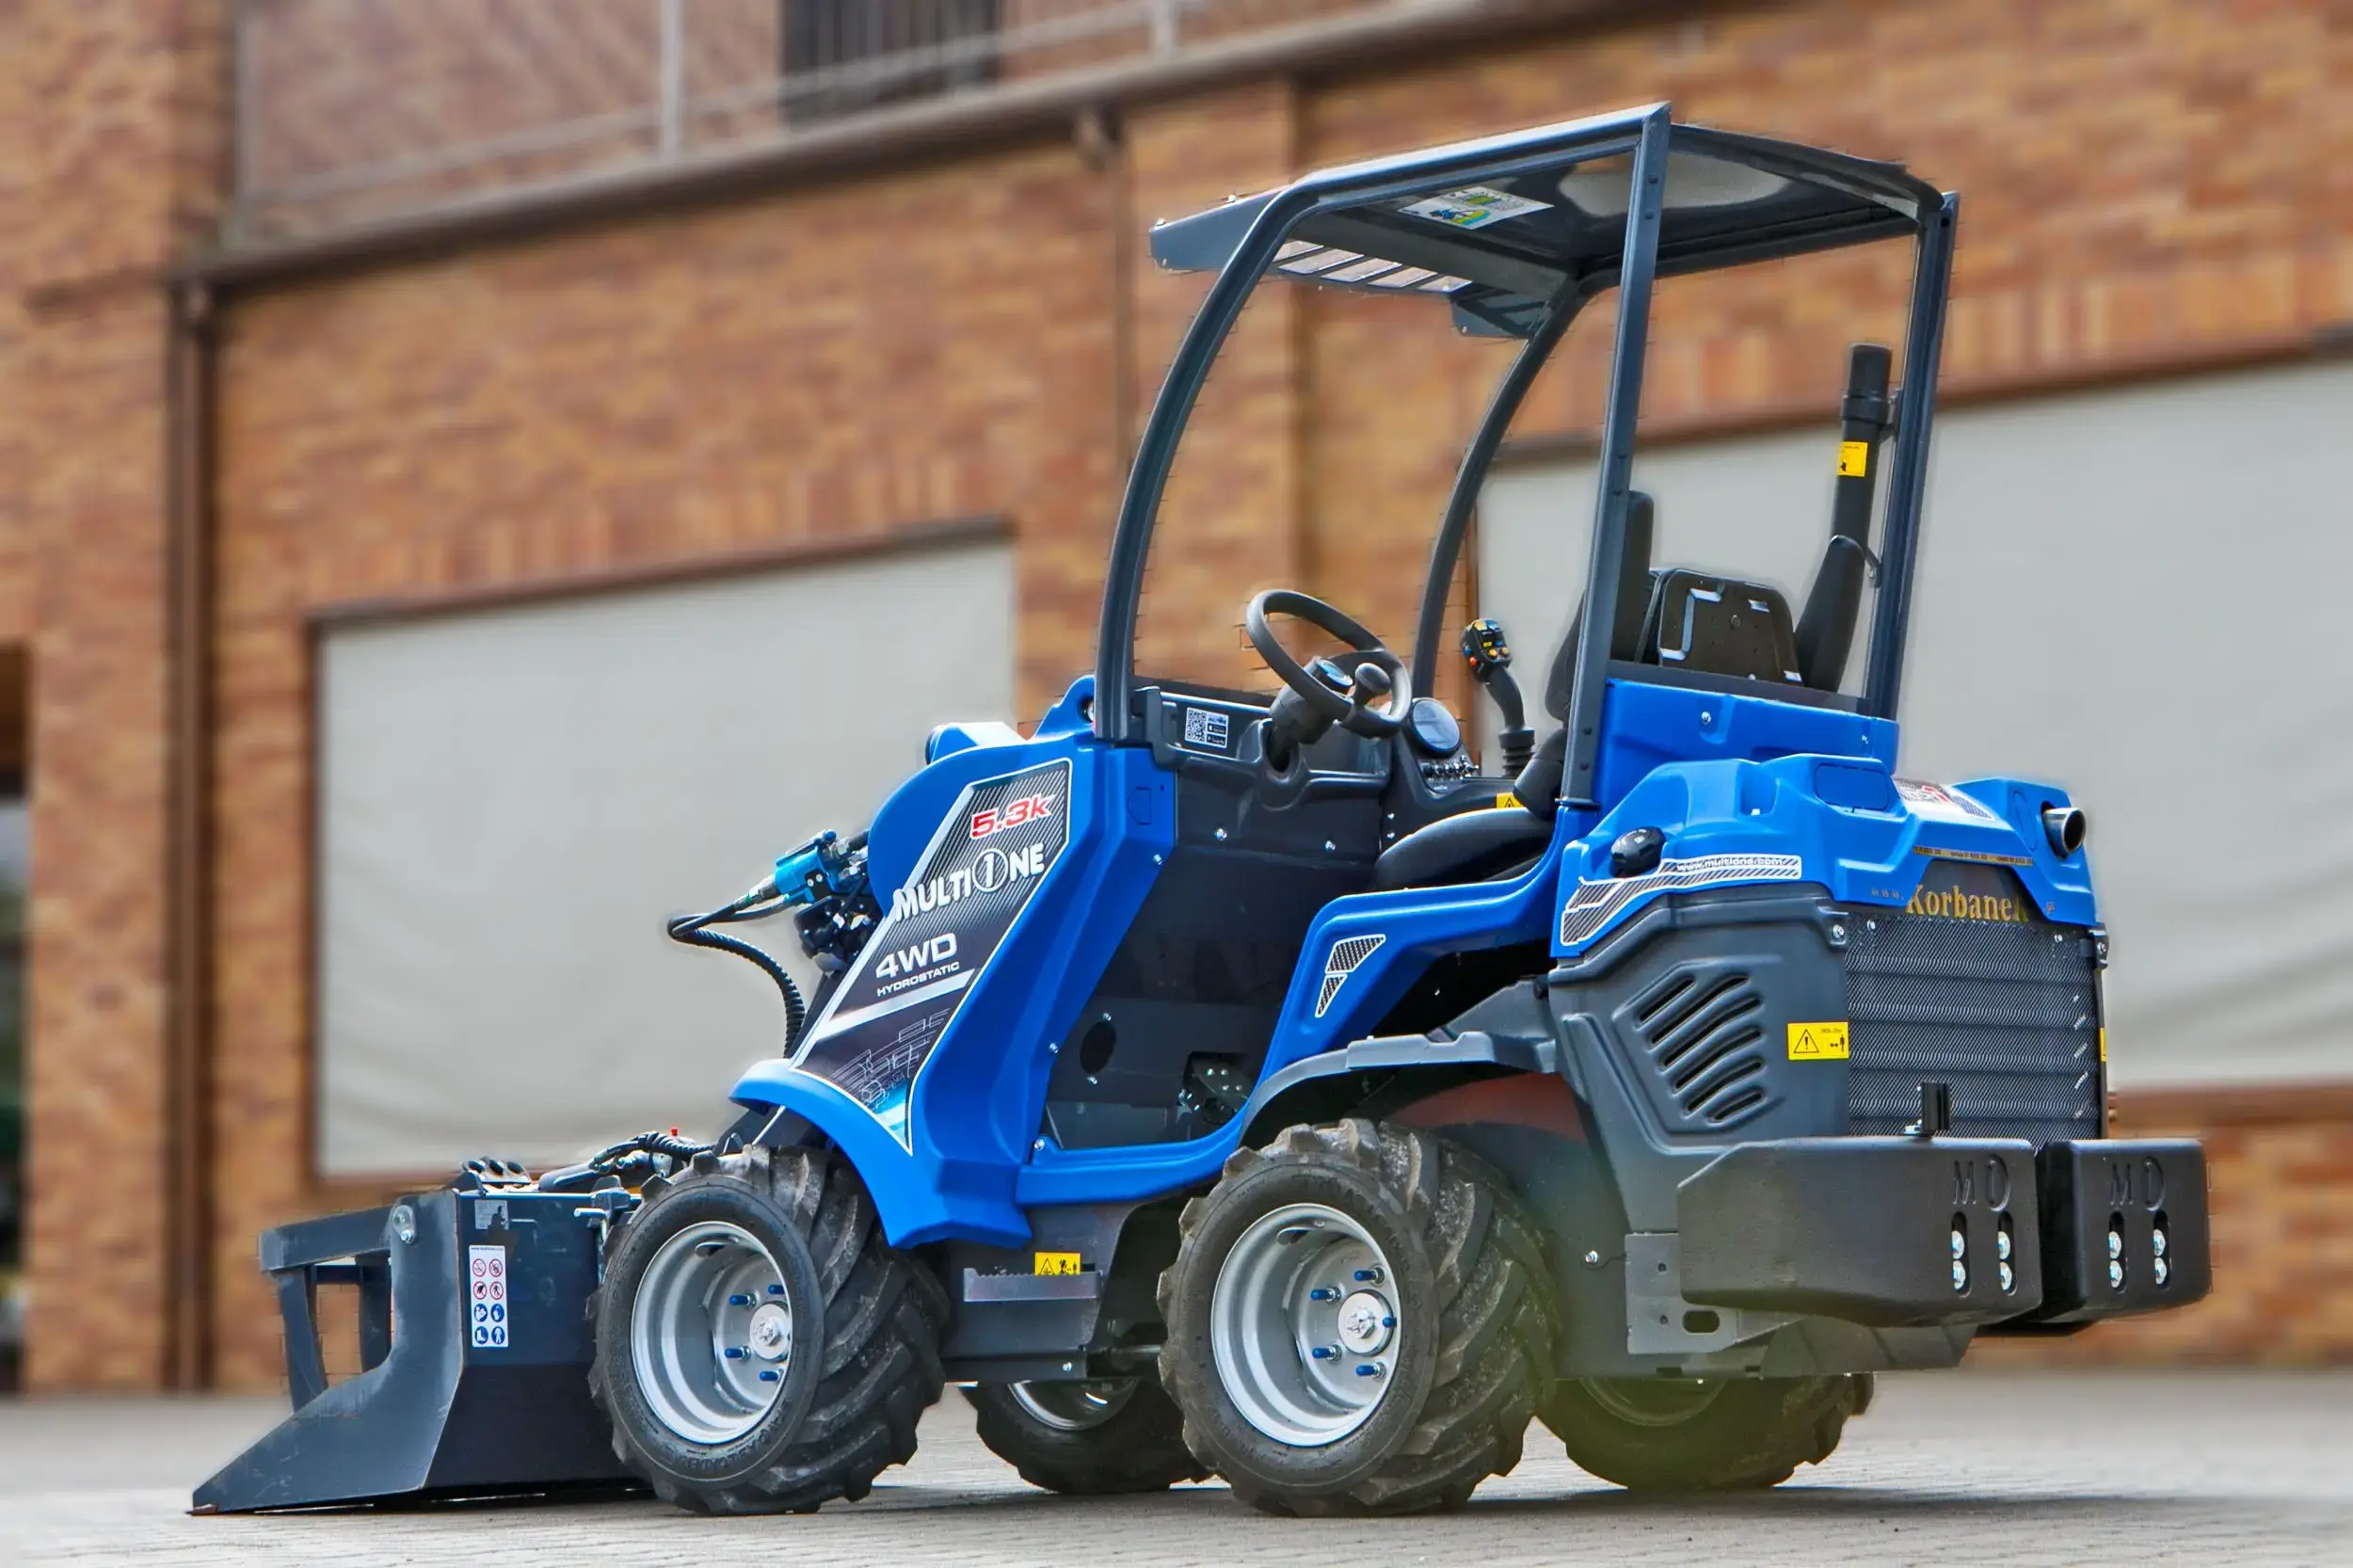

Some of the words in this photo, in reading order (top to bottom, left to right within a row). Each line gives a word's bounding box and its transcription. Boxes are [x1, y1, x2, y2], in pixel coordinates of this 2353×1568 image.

[970, 793, 1054, 840] 5.3k
[875, 933, 958, 979] 4WD
[876, 961, 960, 997] HYDROSTATIC
